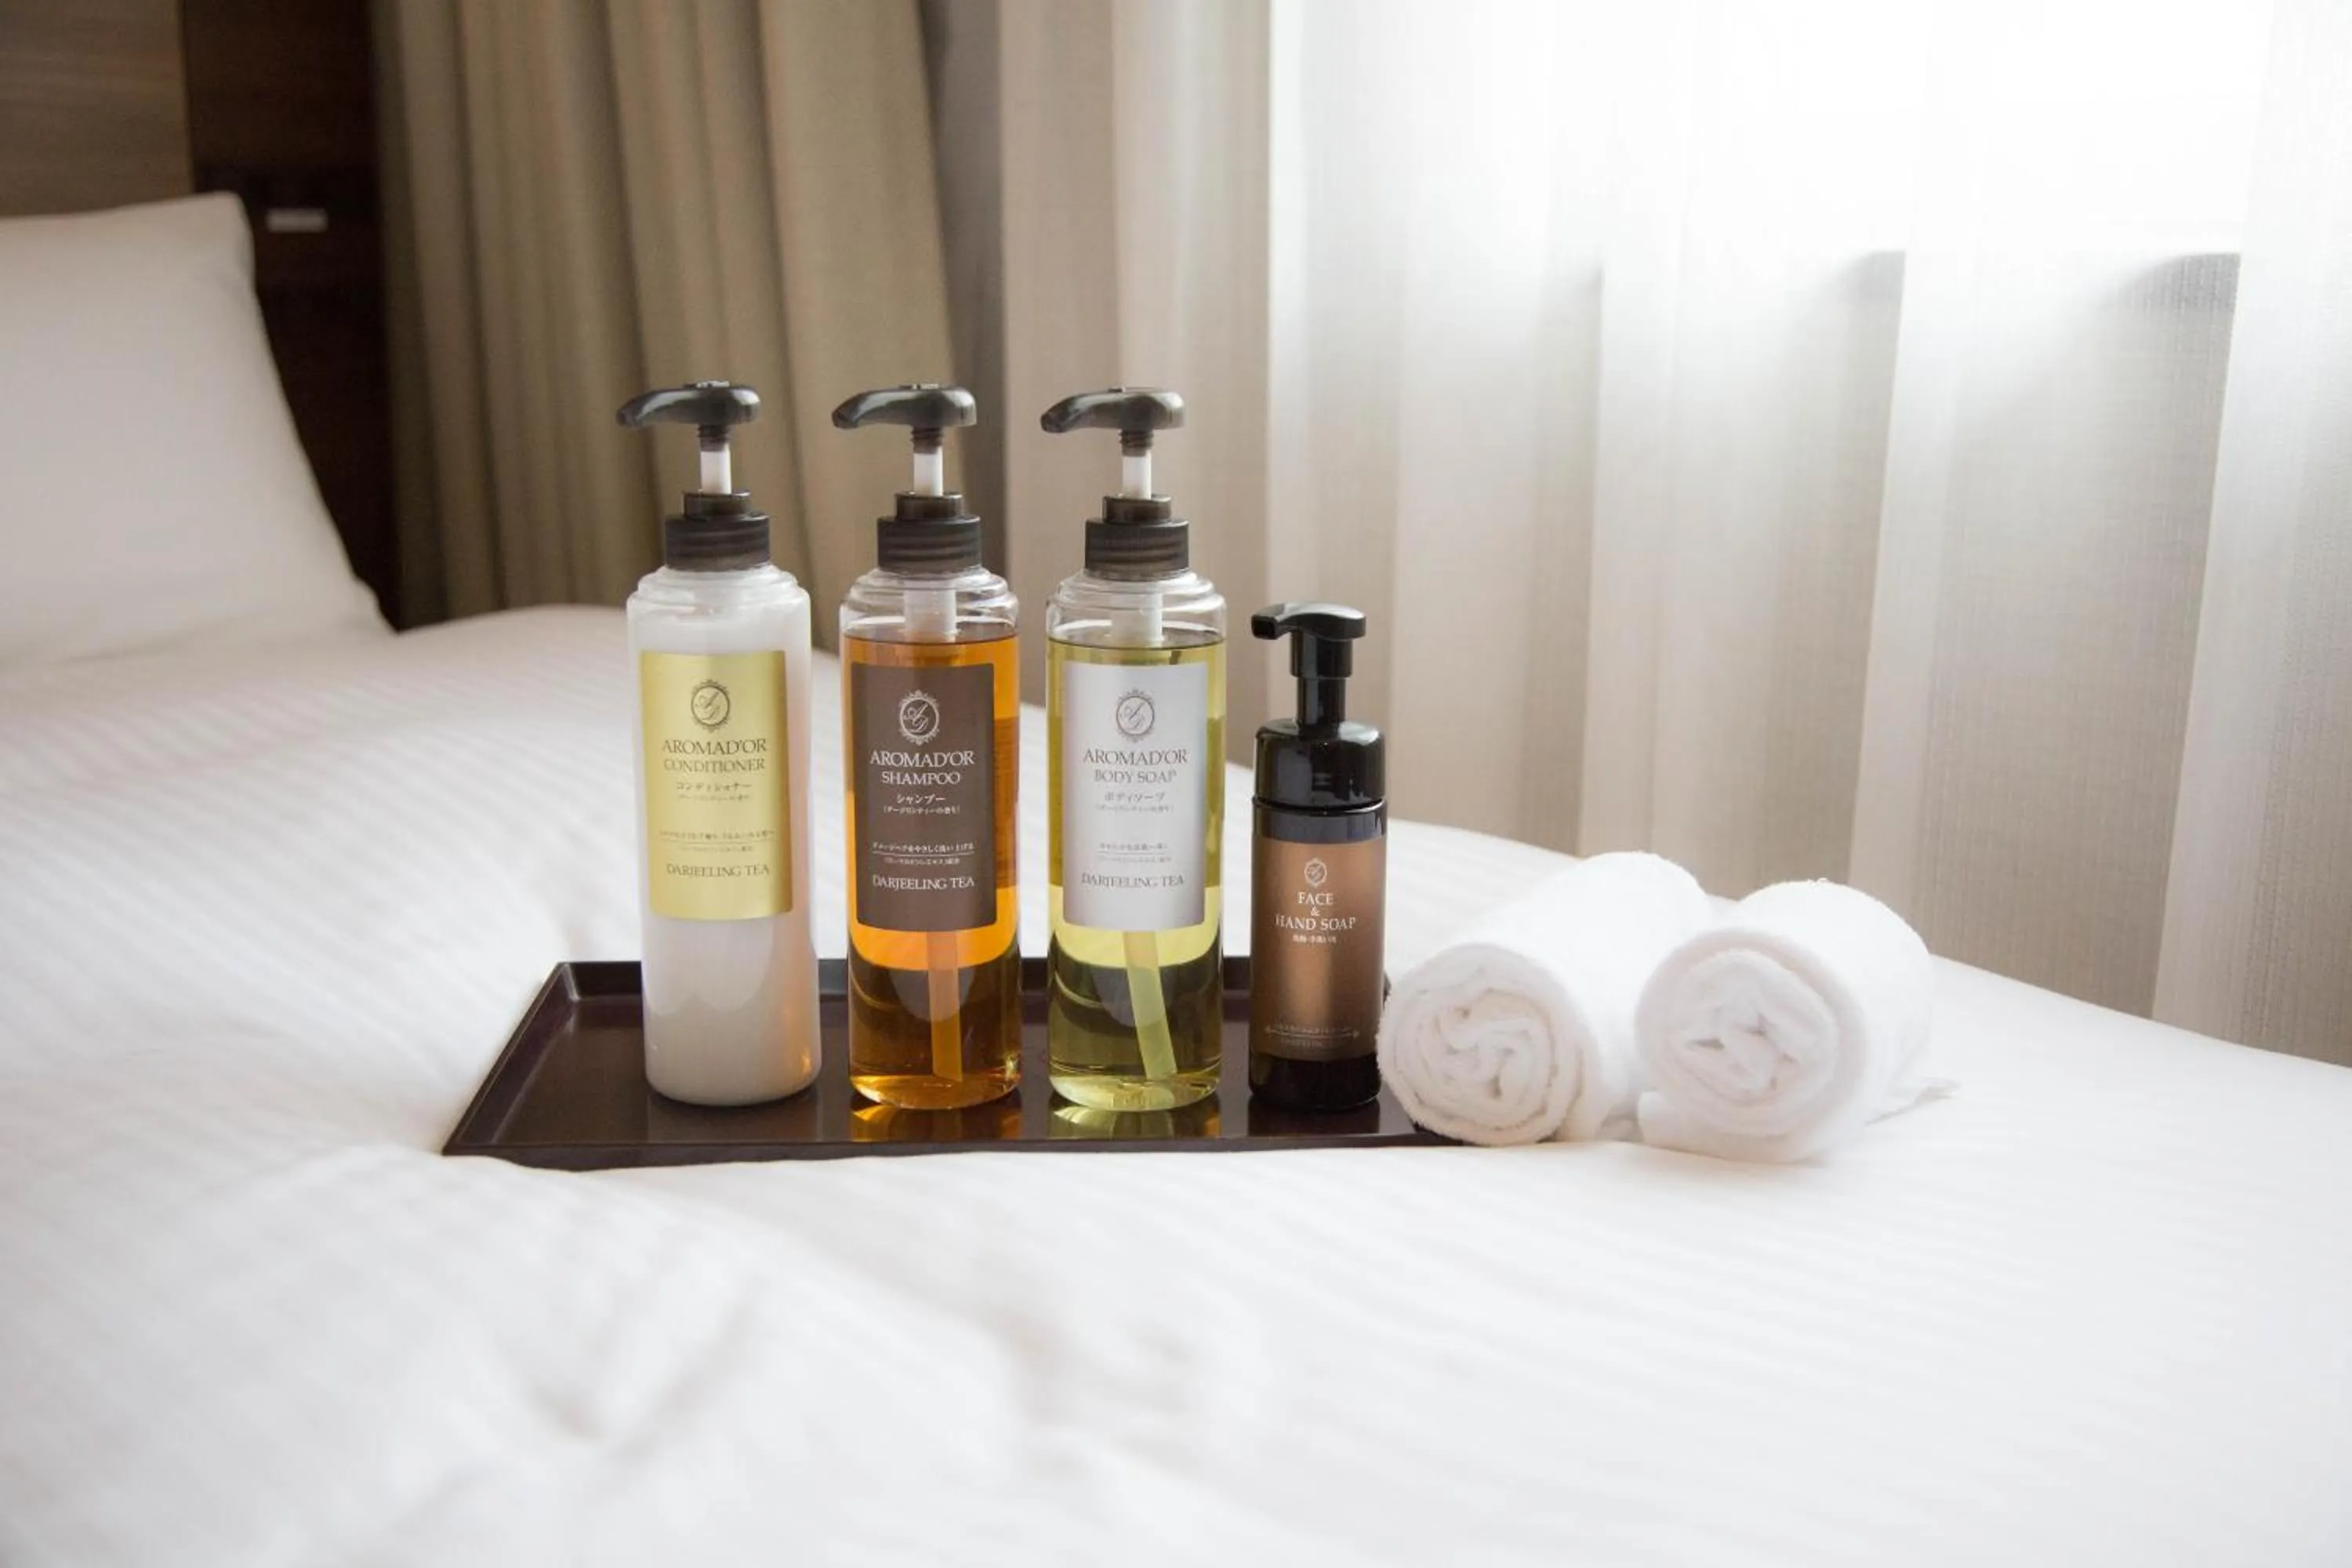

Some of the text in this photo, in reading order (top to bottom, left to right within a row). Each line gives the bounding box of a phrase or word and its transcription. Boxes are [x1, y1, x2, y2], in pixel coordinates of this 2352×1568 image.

[662, 739, 768, 755] AROMAD'OR
[869, 750, 975, 768] AROMAD'OR
[1083, 748, 1189, 766] AROMAD'OR
[664, 758, 766, 773] CONDITIONER
[881, 771, 961, 785] SHAMPOO
[1094, 769, 1178, 783] BODY SOAP
[896, 793, 946, 804] シャンプー
[666, 862, 770, 877] DARJEELING TEA
[872, 874, 975, 891] DARJEELING TEA
[1081, 871, 1185, 887] DARJEELING TEA
[1298, 891, 1334, 906] FACE
[1310, 906, 1320, 916] &
[1275, 913, 1356, 931] HAND SOAP
